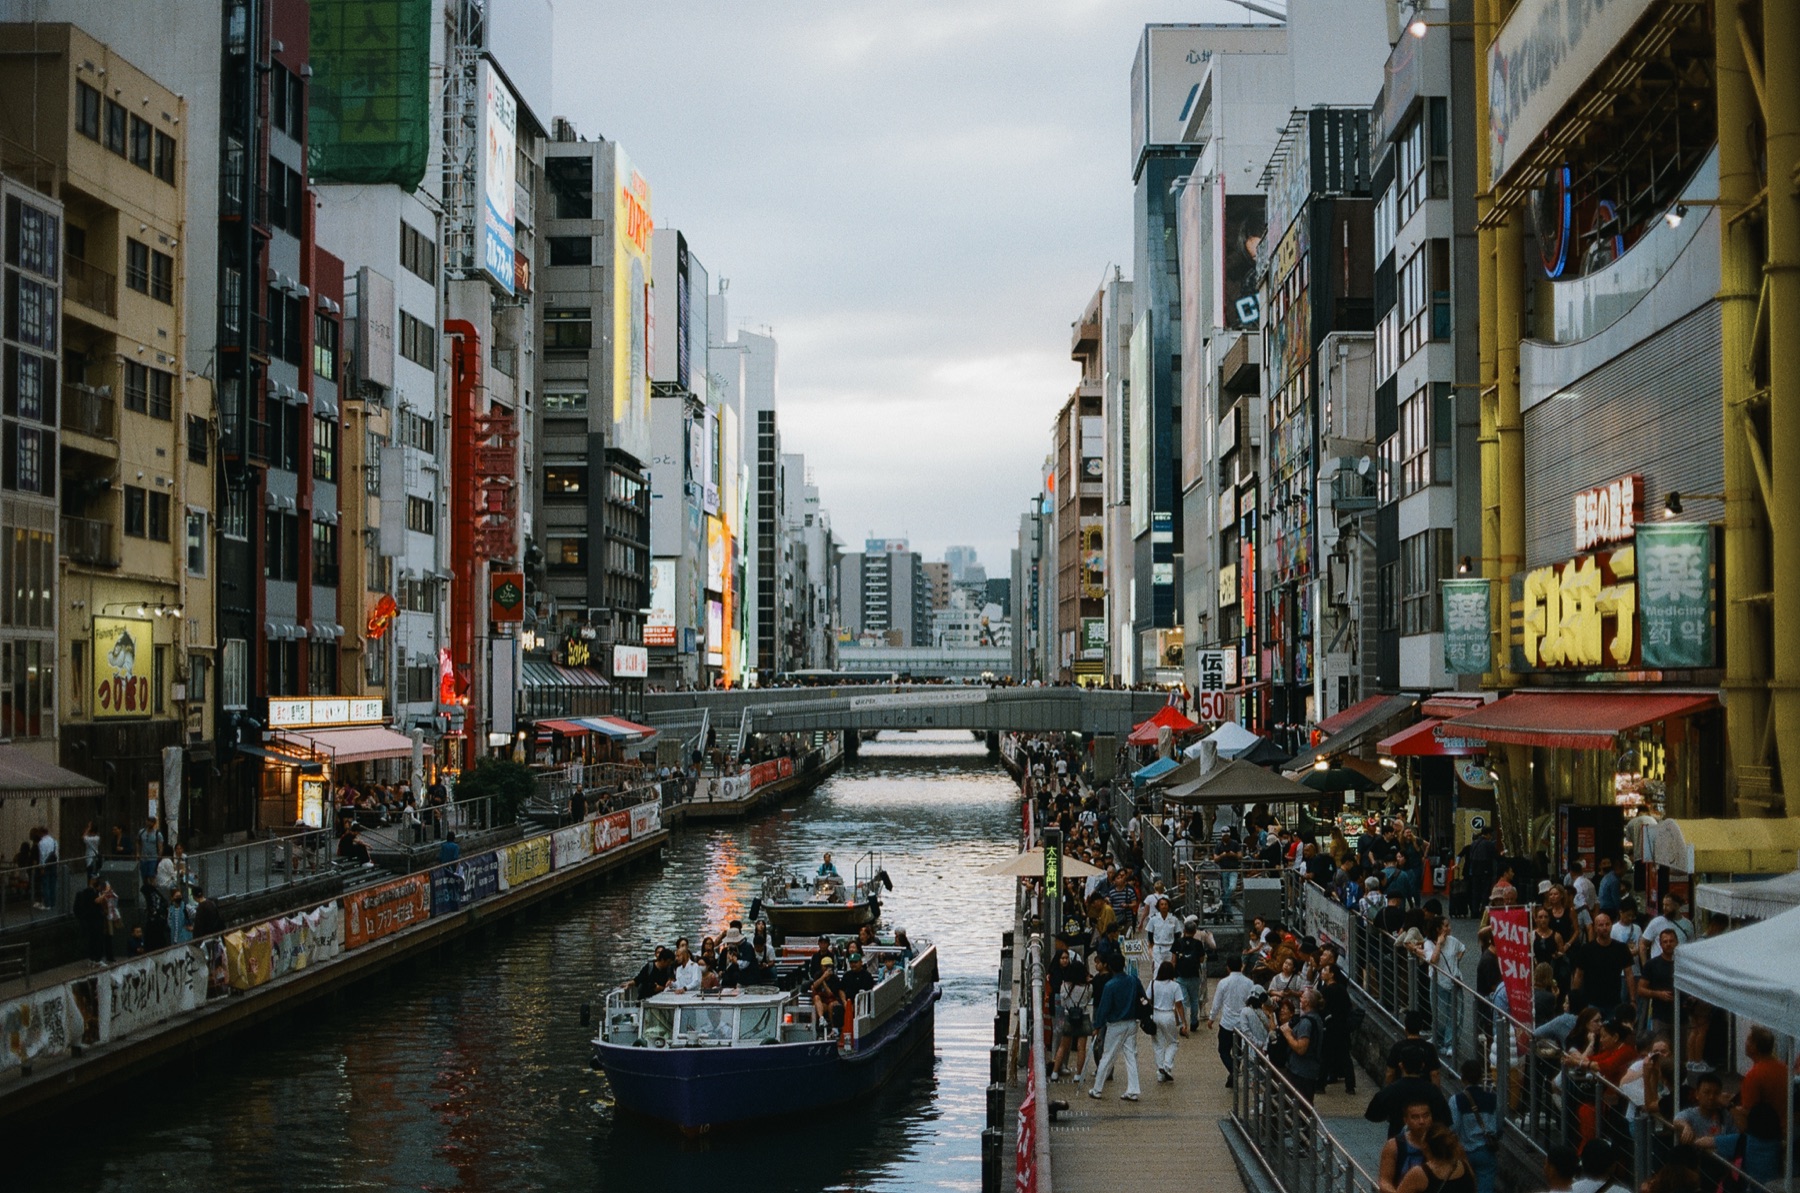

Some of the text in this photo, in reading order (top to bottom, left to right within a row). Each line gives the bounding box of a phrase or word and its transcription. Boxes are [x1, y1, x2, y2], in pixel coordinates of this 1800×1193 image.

[1645, 544, 1703, 600] 薬
[1448, 593, 1486, 630] 薬
[1646, 606, 1705, 616] Medicine
[1448, 633, 1488, 641] Medicine
[1648, 620, 1672, 645] 药
[1680, 620, 1705, 646] 약
[1201, 653, 1223, 691] 伝串
[1201, 692, 1225, 720] 50
